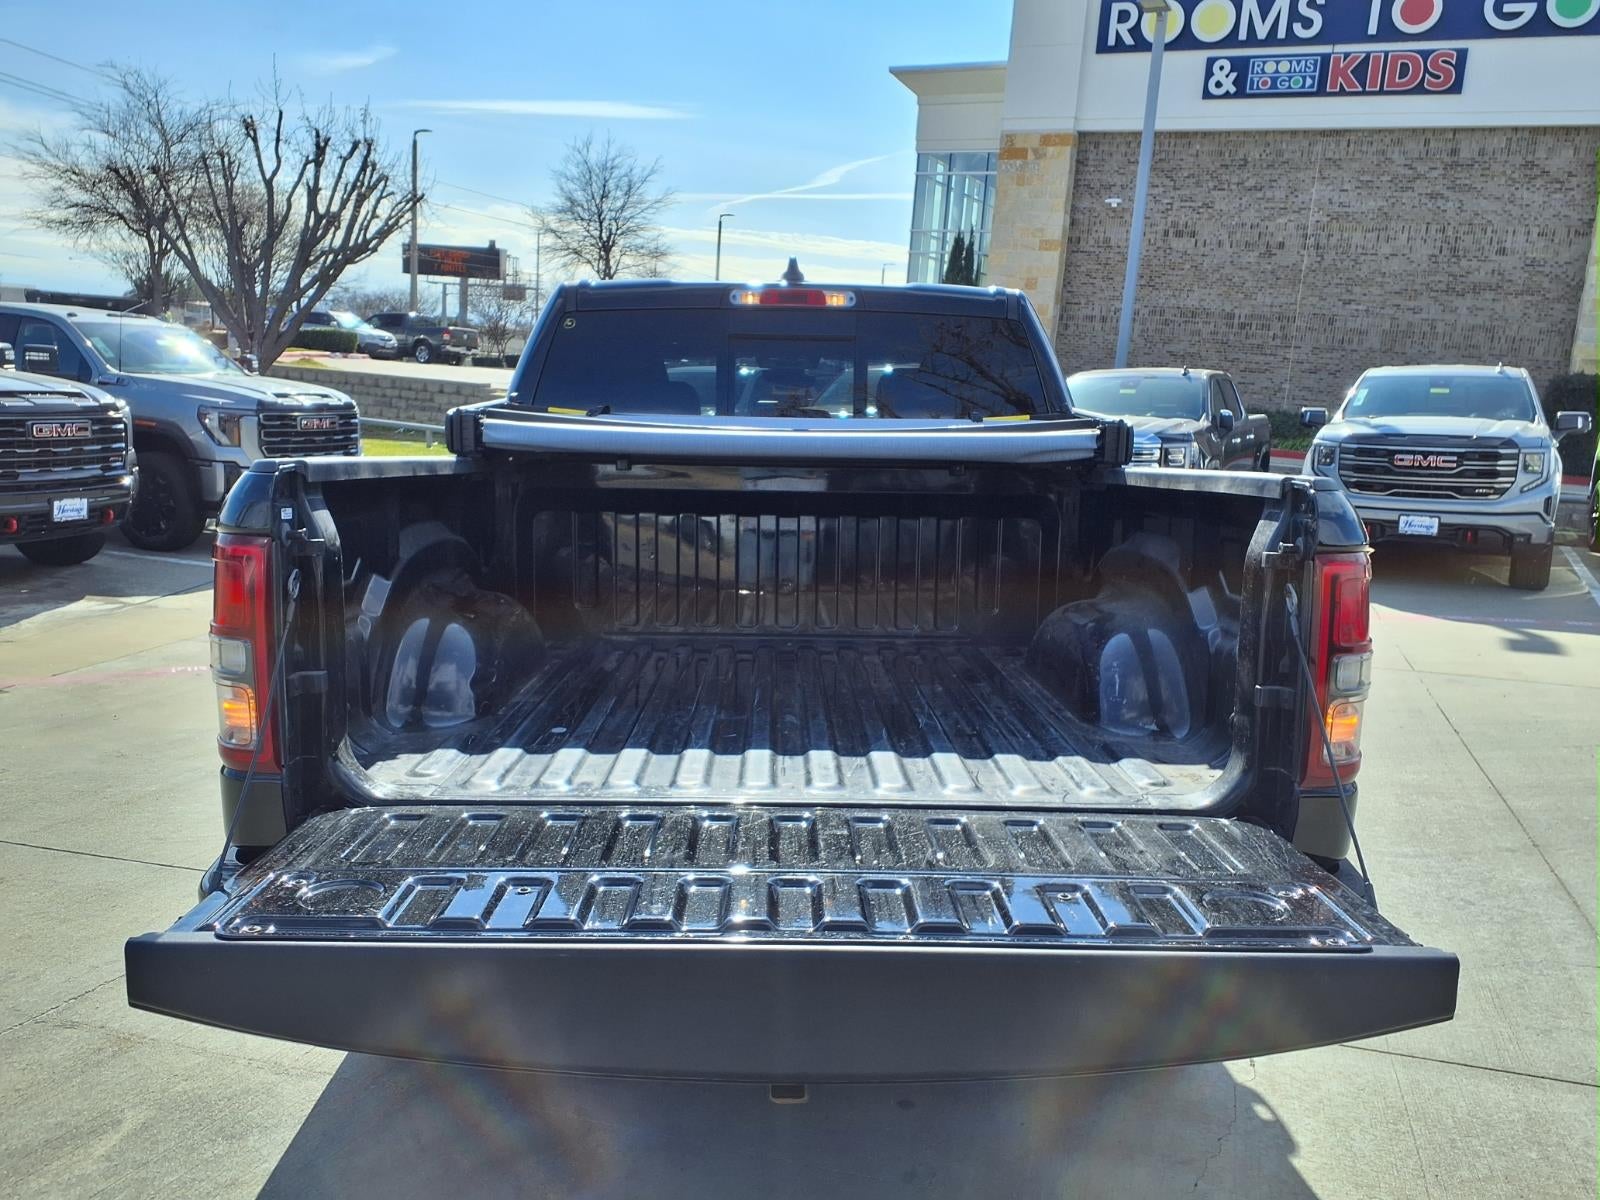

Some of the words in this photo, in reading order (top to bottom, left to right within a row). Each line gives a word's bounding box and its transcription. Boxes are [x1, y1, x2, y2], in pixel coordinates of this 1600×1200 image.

[1107, 0, 1326, 46] ROOMS
[1483, 0, 1600, 31] GO
[1253, 60, 1315, 74] ROOMS
[1326, 49, 1457, 93] KIDS
[1207, 58, 1238, 96] &
[1252, 76, 1271, 90] TO
[1277, 75, 1303, 89] GO
[33, 423, 90, 438] GMC
[301, 418, 337, 430] GMC
[1394, 454, 1458, 468] GMC
